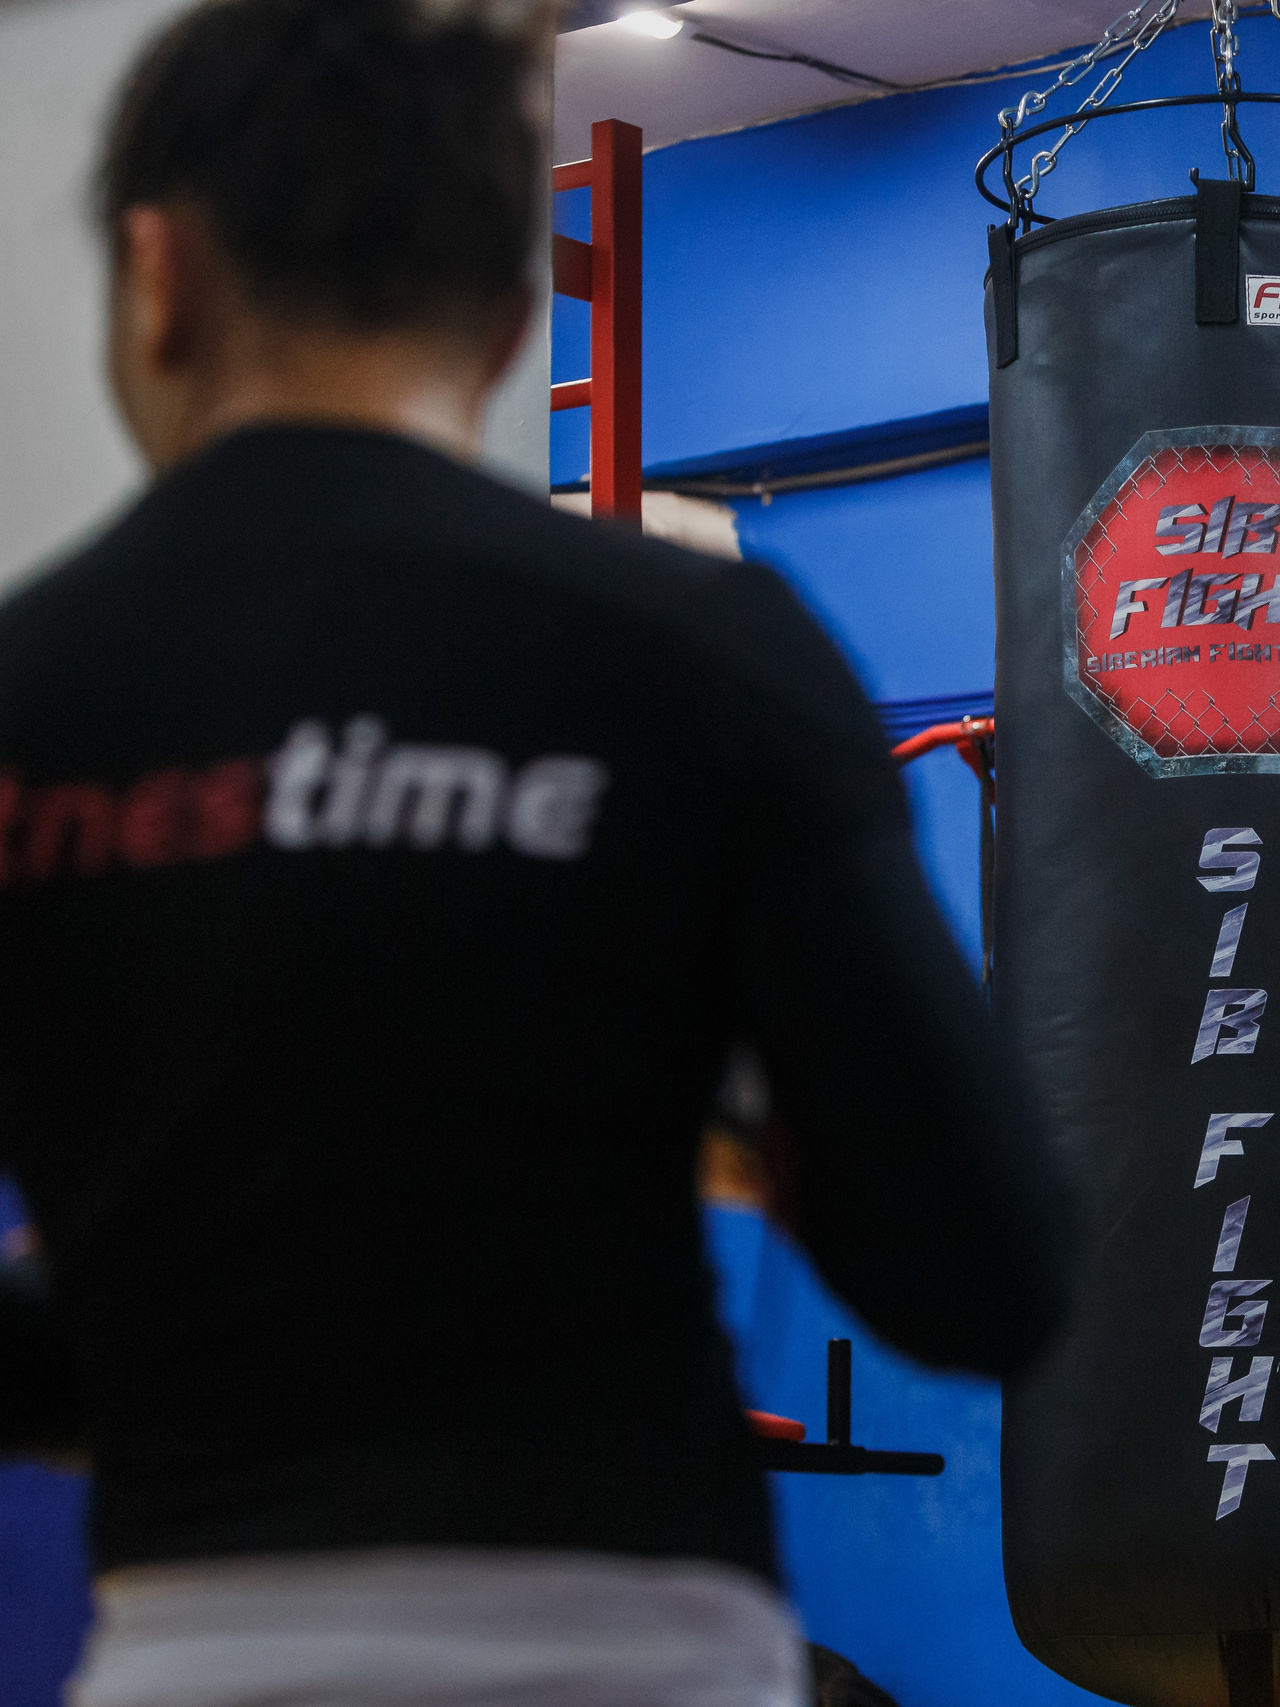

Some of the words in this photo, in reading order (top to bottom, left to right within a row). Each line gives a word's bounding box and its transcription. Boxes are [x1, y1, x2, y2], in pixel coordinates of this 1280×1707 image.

[1087, 646, 1200, 673] SIBERIAN
[1191, 827, 1268, 1065] SIB
[1193, 1112, 1276, 1521] FIGHT
